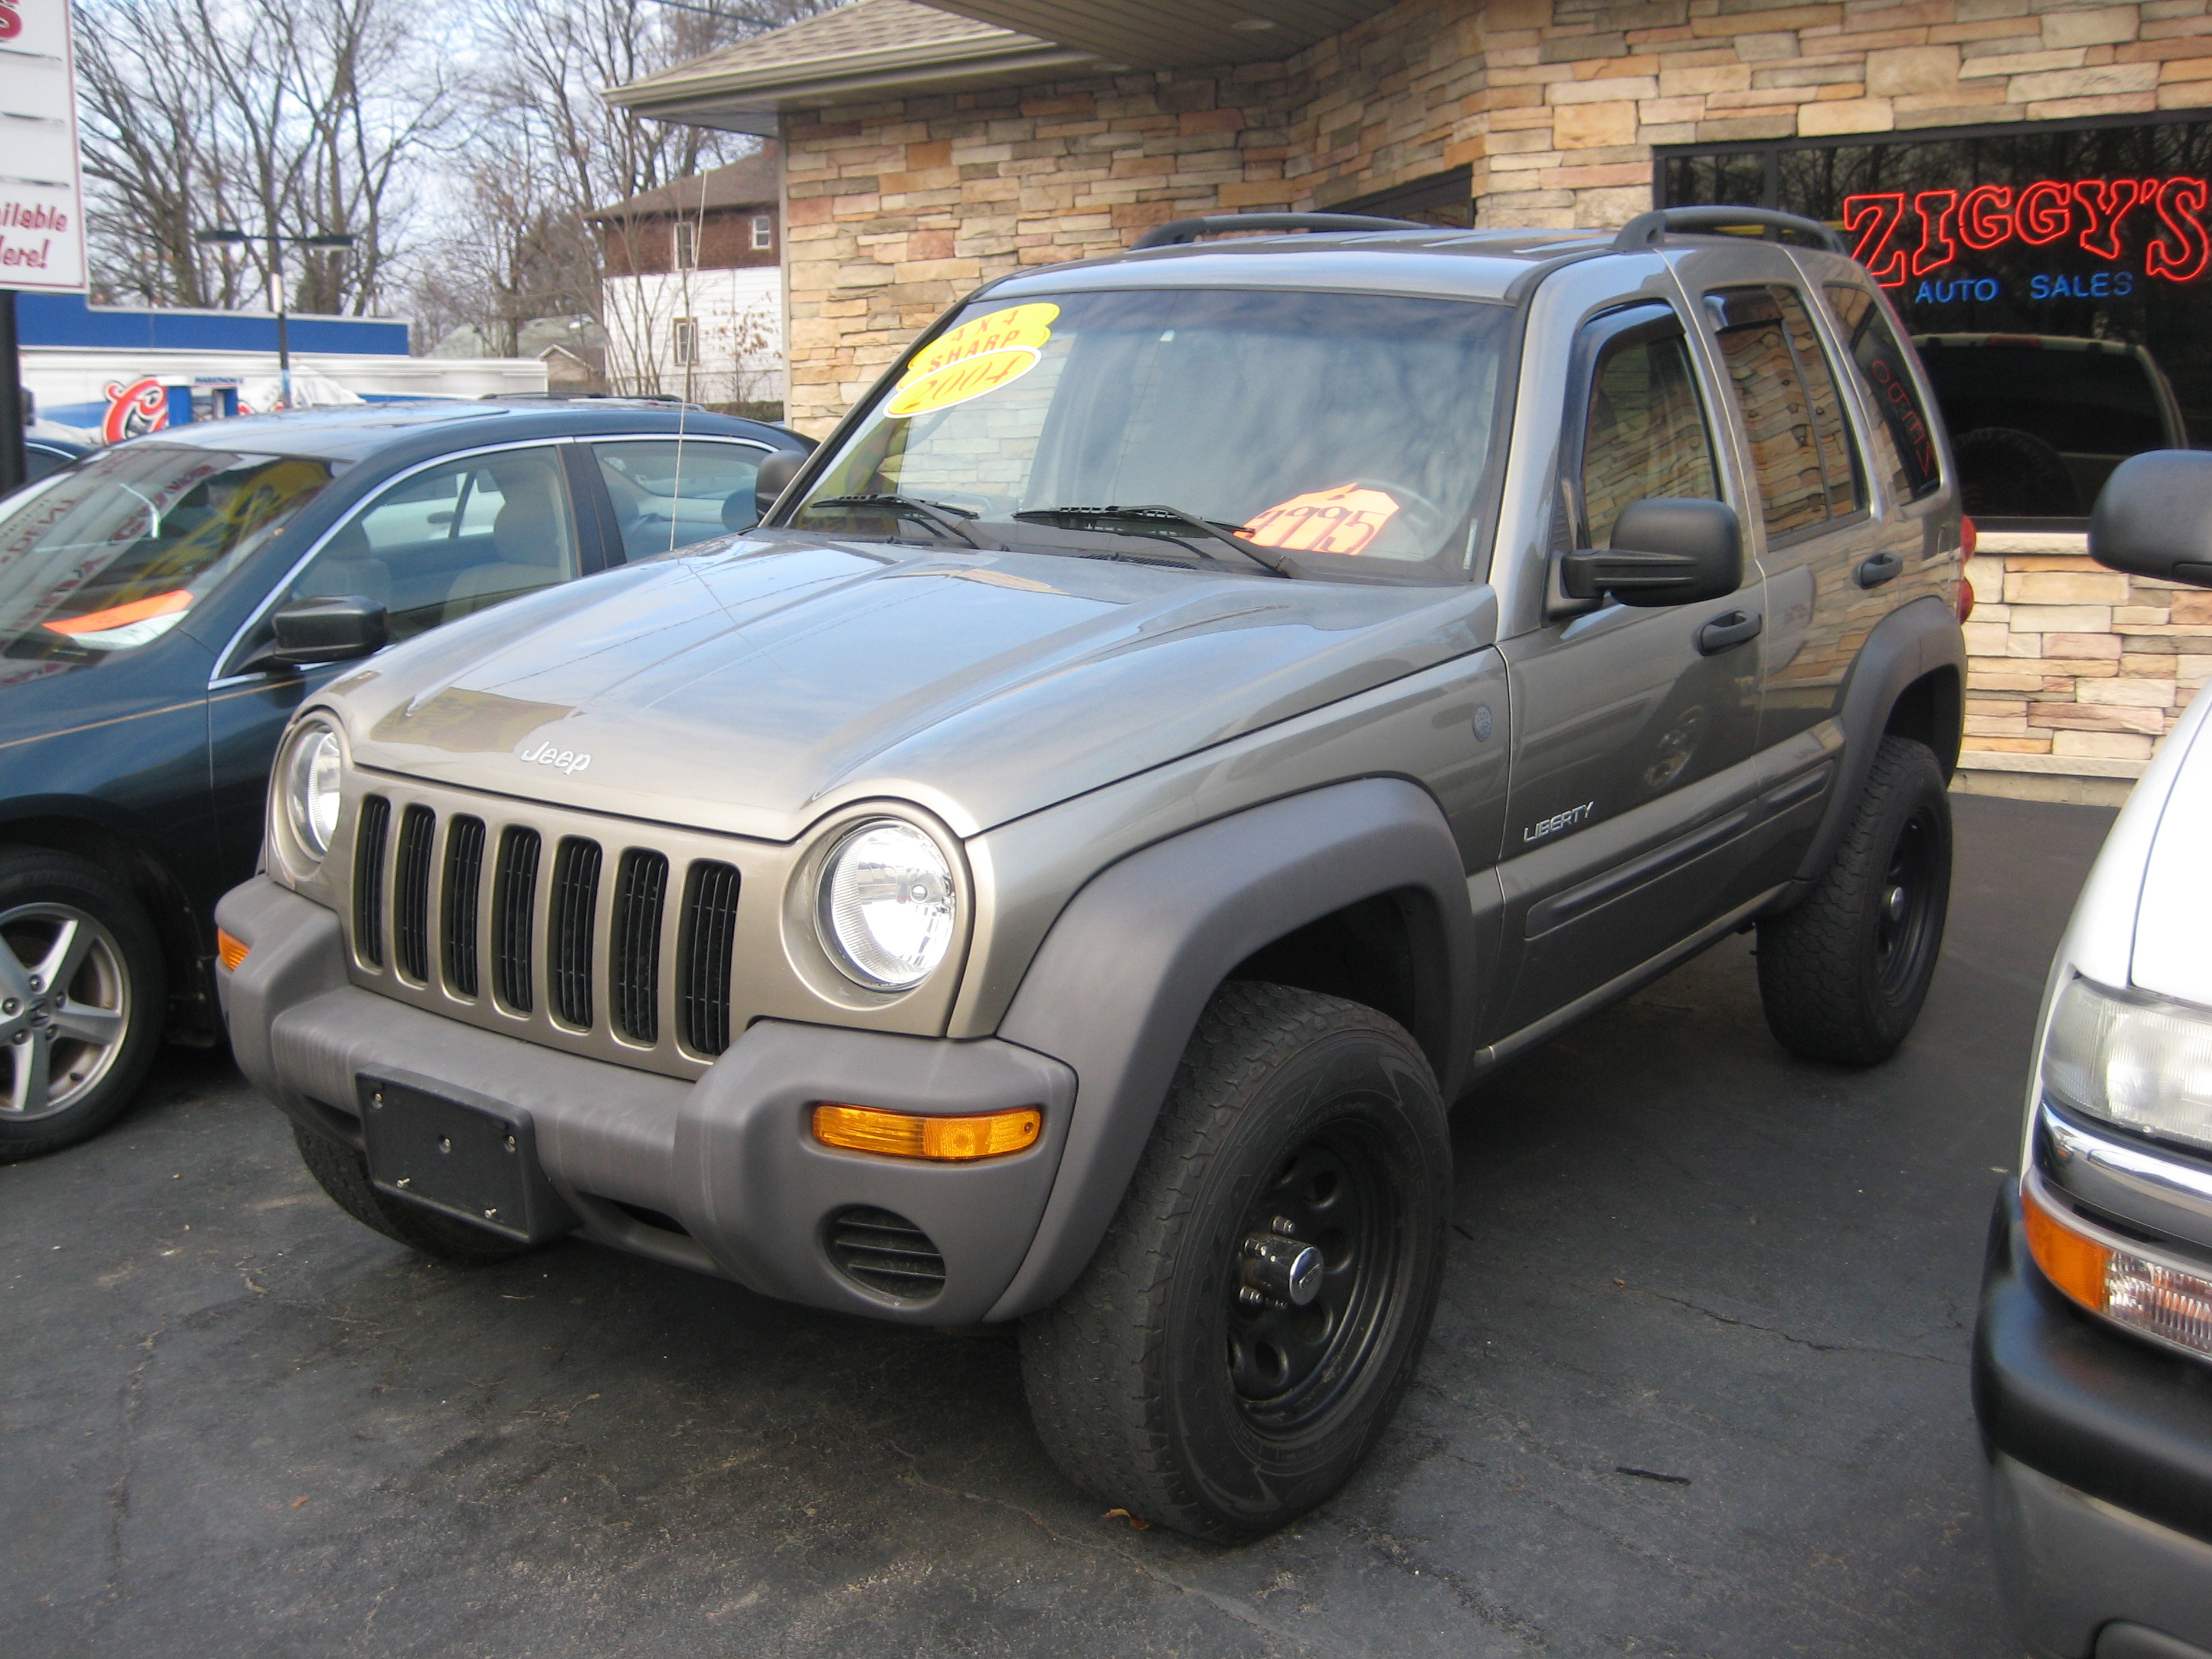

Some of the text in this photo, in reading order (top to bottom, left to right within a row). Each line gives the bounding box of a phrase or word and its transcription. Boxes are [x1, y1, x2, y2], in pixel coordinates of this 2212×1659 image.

[0, 202, 68, 233] ilable
[1843, 176, 2211, 288] ZIGGY'S
[0, 235, 51, 269] ere!
[1914, 271, 2134, 305] AUTO SALES
[927, 329, 1021, 374] SHARP
[900, 354, 1022, 411] 2004
[1254, 505, 1388, 556] 7995
[520, 740, 593, 775] Jeep
[1523, 800, 1594, 843] LIBERTY
